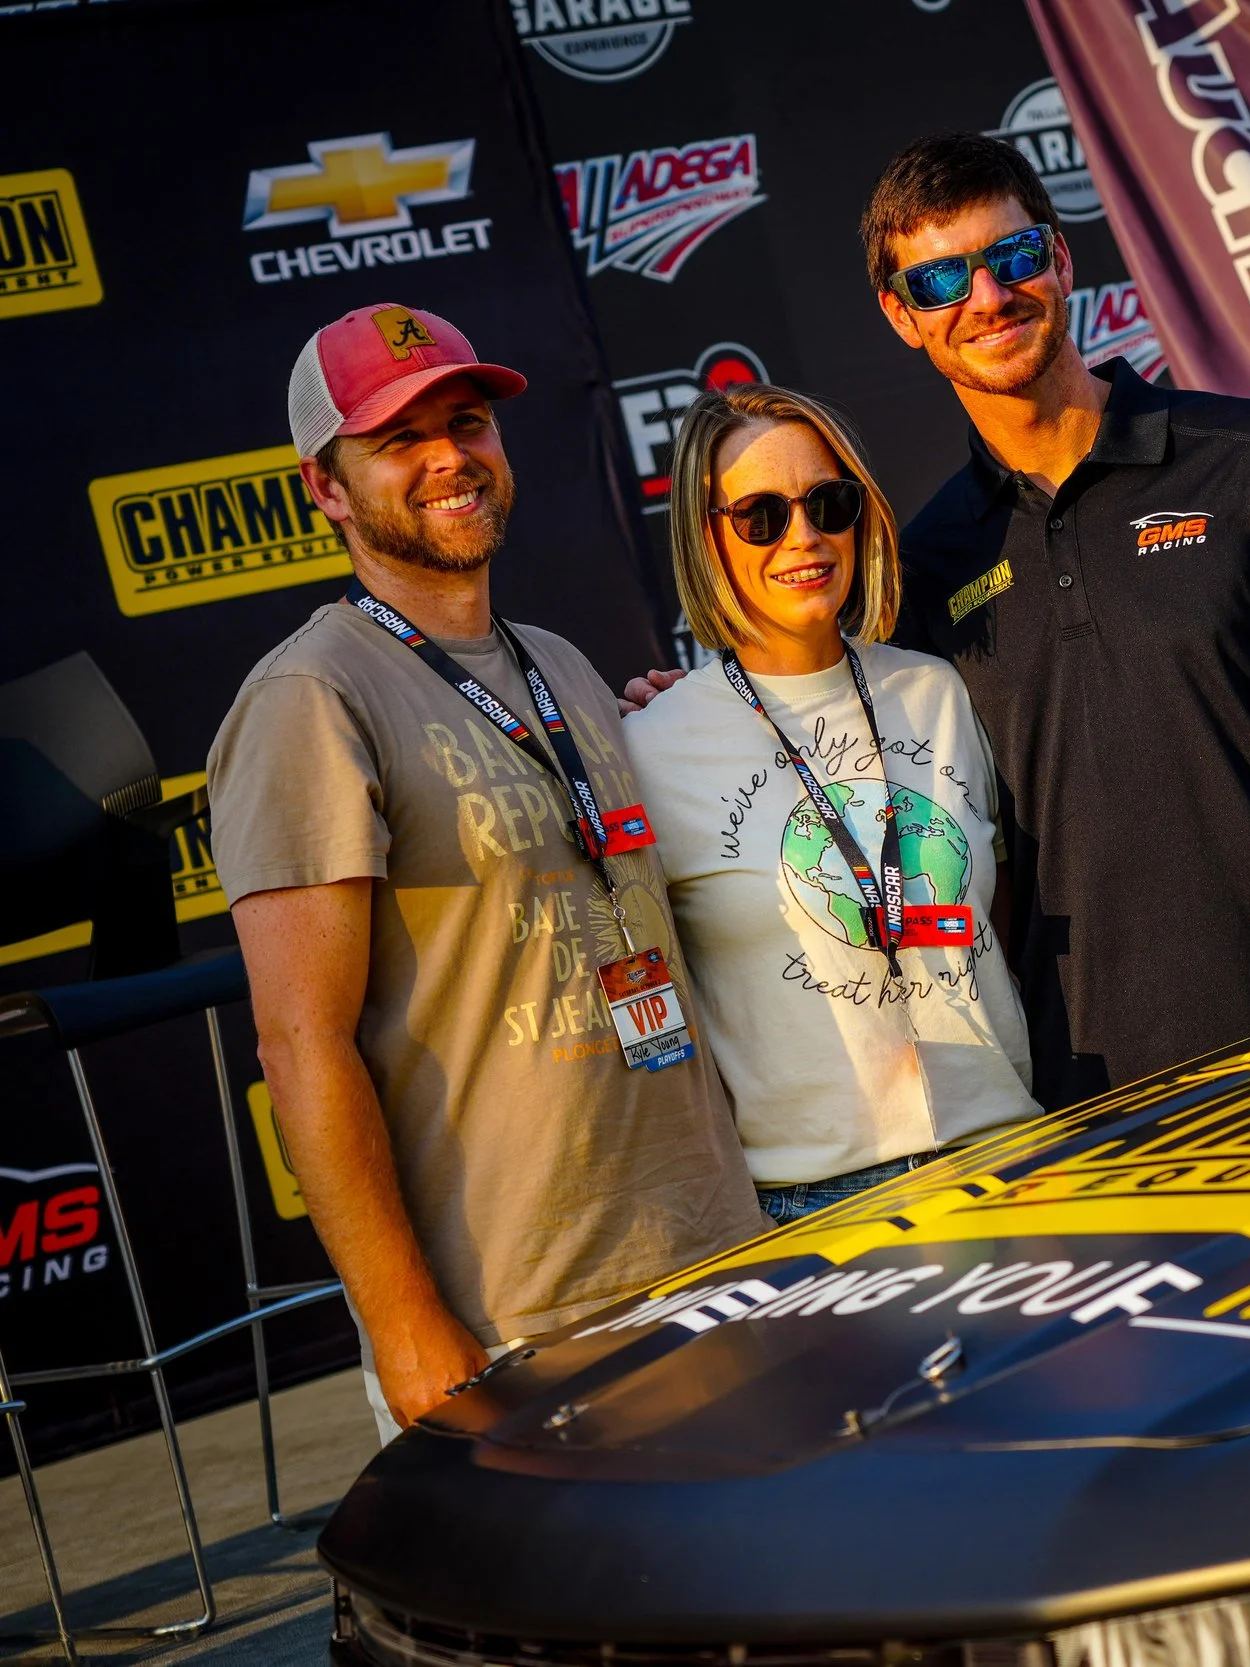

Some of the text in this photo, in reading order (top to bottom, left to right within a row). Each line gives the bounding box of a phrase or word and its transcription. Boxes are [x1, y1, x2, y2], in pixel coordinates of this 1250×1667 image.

[249, 217, 493, 284] CHEVROLET
[392, 318, 429, 347] A
[1137, 517, 1208, 548] GMS
[1137, 534, 1207, 557] RACING
[948, 560, 1013, 617] CHAMPION
[357, 595, 412, 636] NASCAR
[458, 679, 516, 729] NASCAR
[526, 666, 558, 718] NASCAR
[724, 658, 755, 705] NASCAR
[574, 780, 607, 838] NASCAR
[798, 767, 839, 821] NASCAR
[884, 865, 903, 927] NASCAR
[552, 937, 591, 983] DE
[781, 951, 872, 1006] treat
[938, 920, 994, 1002] right
[504, 1001, 541, 1047] ST
[626, 995, 668, 1037] VIP
[657, 1048, 686, 1067] PLAYOFFS
